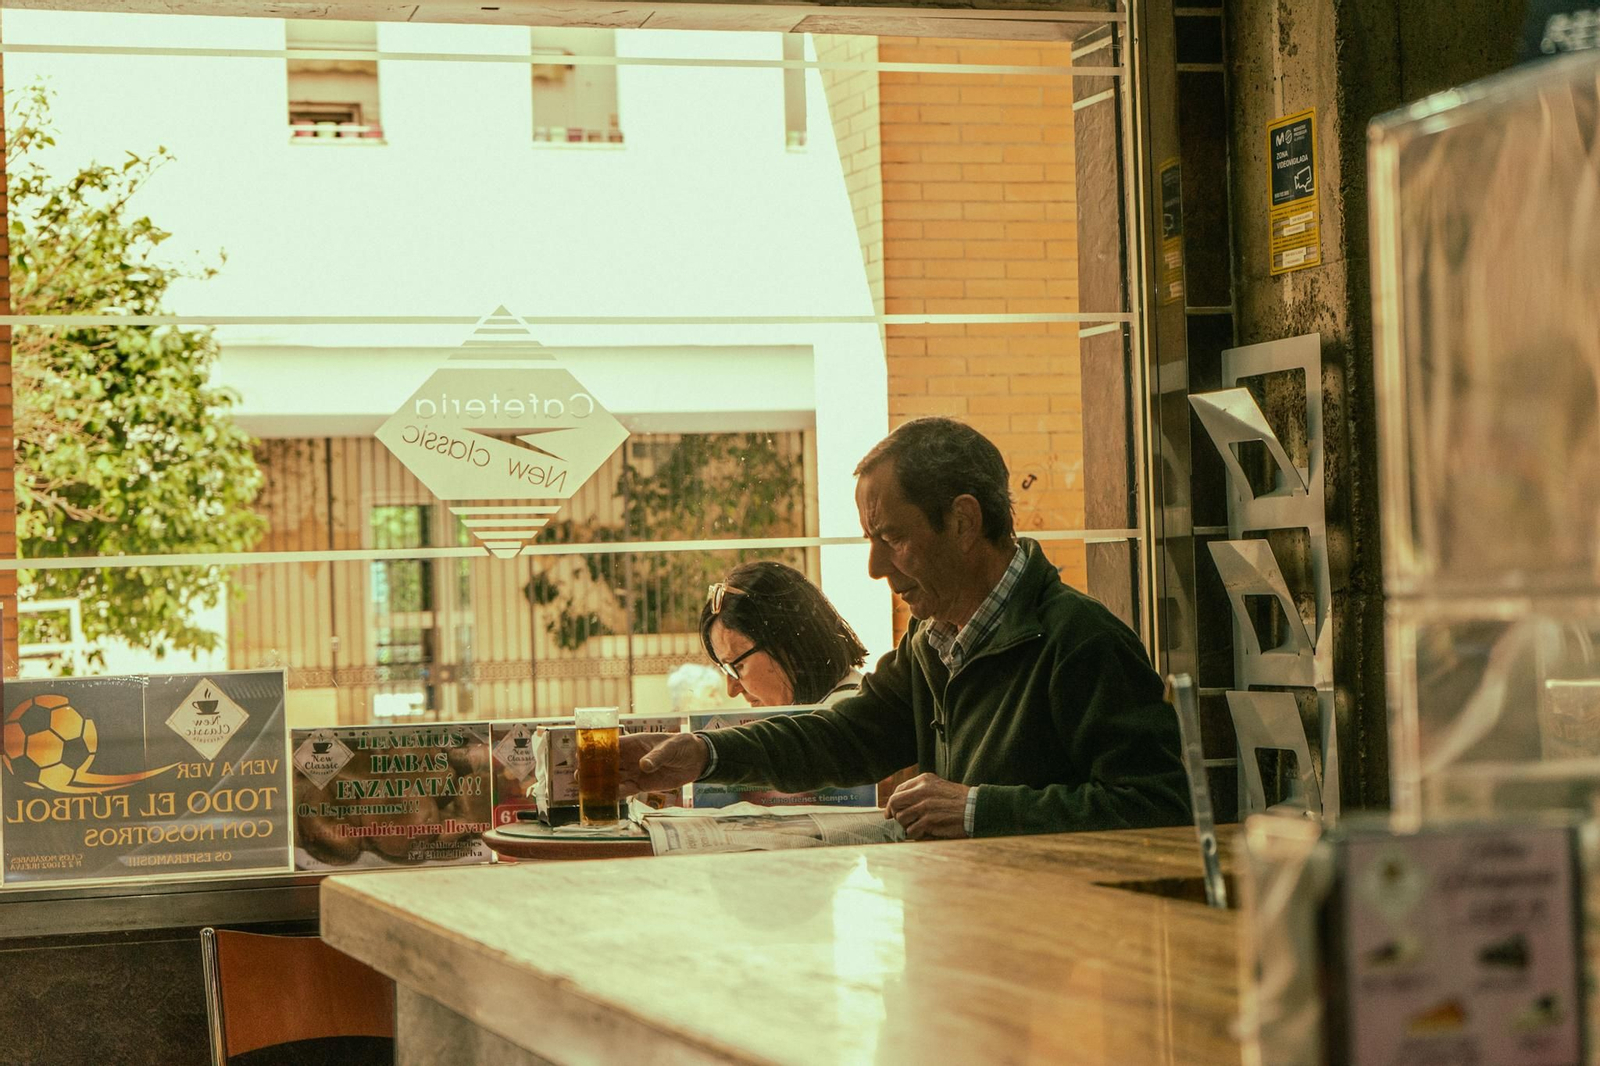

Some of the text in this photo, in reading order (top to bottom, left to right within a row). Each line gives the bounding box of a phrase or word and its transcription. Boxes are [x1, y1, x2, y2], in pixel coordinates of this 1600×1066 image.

[1276, 150, 1288, 160] ZONA
[1276, 154, 1308, 169] VIDEOVIGILADA
[358, 731, 463, 749] TENEMOS
[305, 761, 339, 770] Classic
[311, 754, 333, 762] New
[370, 752, 449, 774] HABAS
[336, 774, 482, 799] ENZAPATÁ!!!
[819, 794, 848, 803] tiempo
[298, 800, 420, 819] Os Esperamos!!!
[338, 819, 490, 838] También para llevar
[453, 849, 482, 858] Huelva
